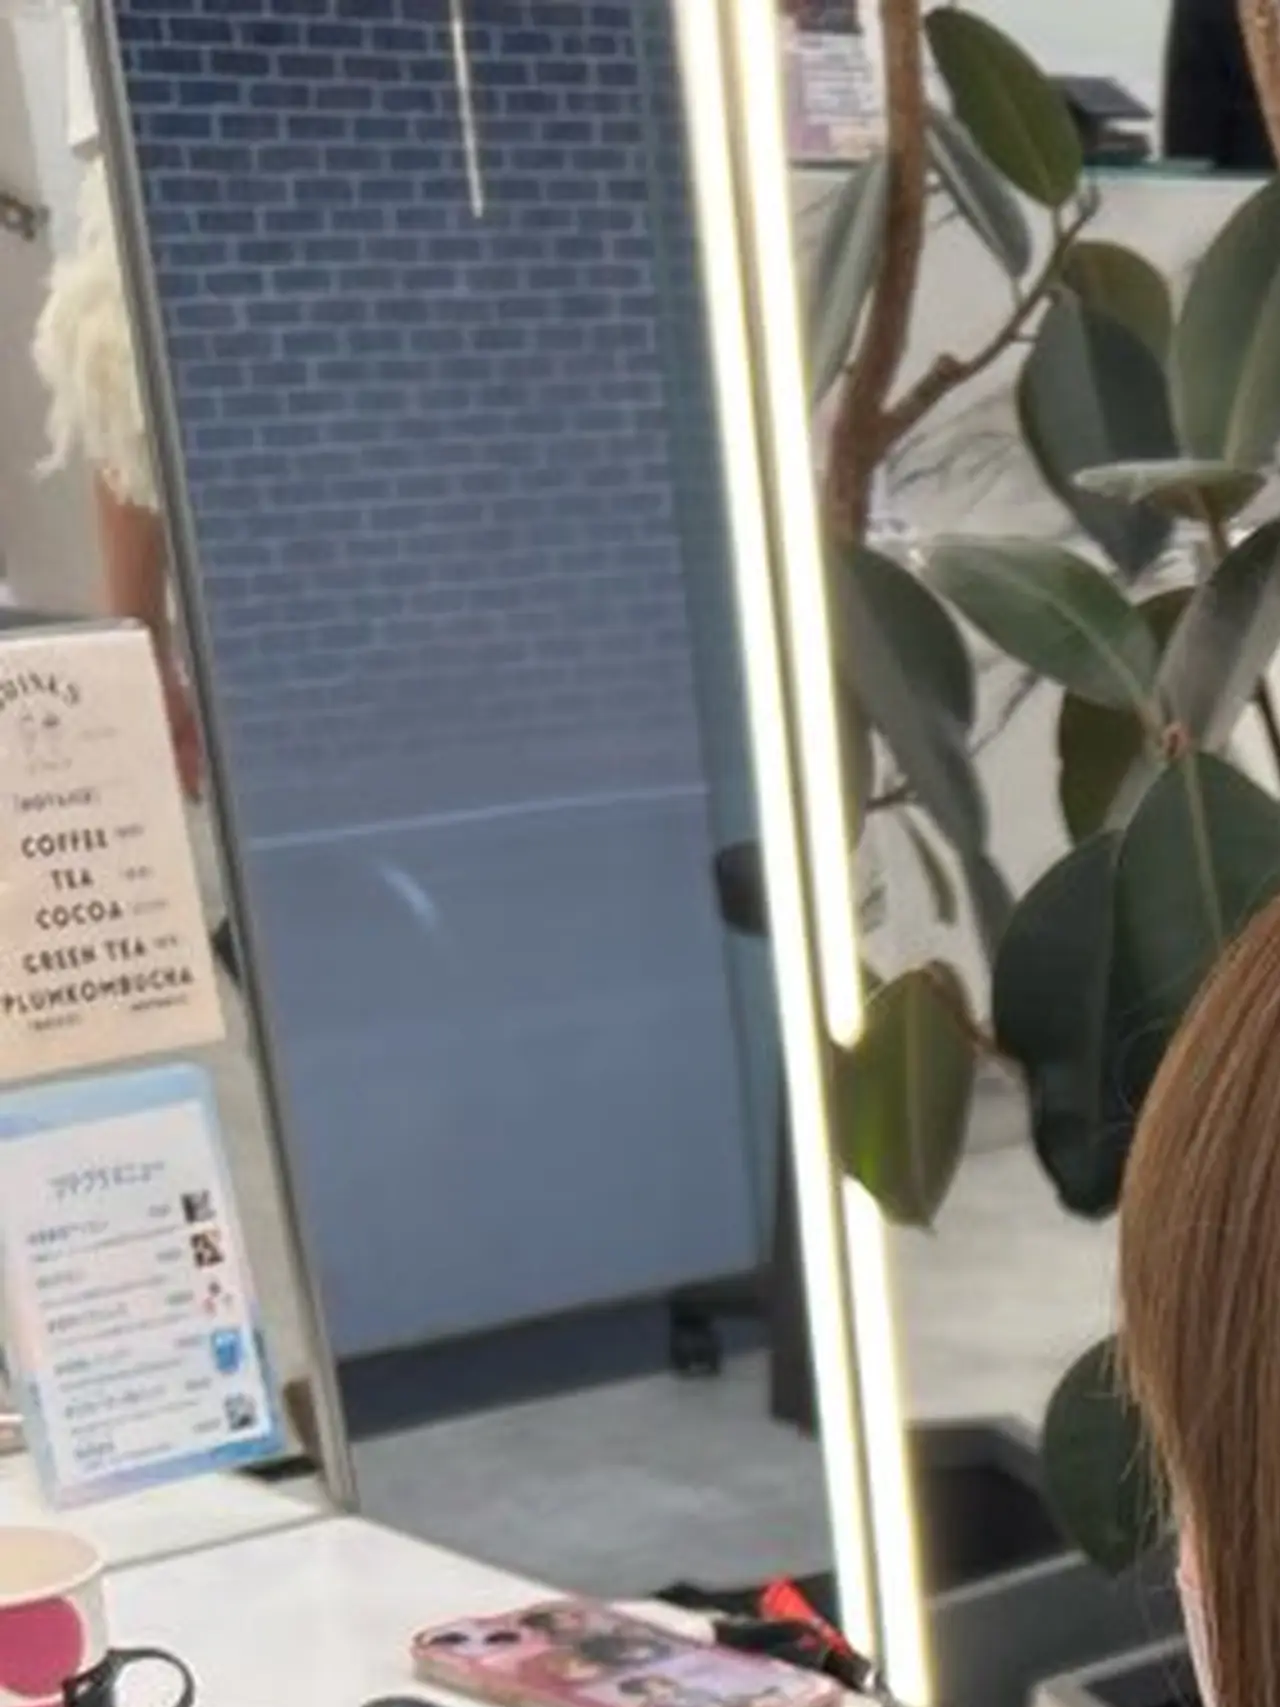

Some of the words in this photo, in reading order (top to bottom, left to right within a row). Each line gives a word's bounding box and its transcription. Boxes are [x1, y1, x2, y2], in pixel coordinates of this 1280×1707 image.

[21, 828, 108, 859] COFFEE
[51, 867, 94, 891] TEA
[35, 899, 124, 930] COCOA
[22, 945, 96, 974] GREEN
[104, 936, 147, 962] TEA
